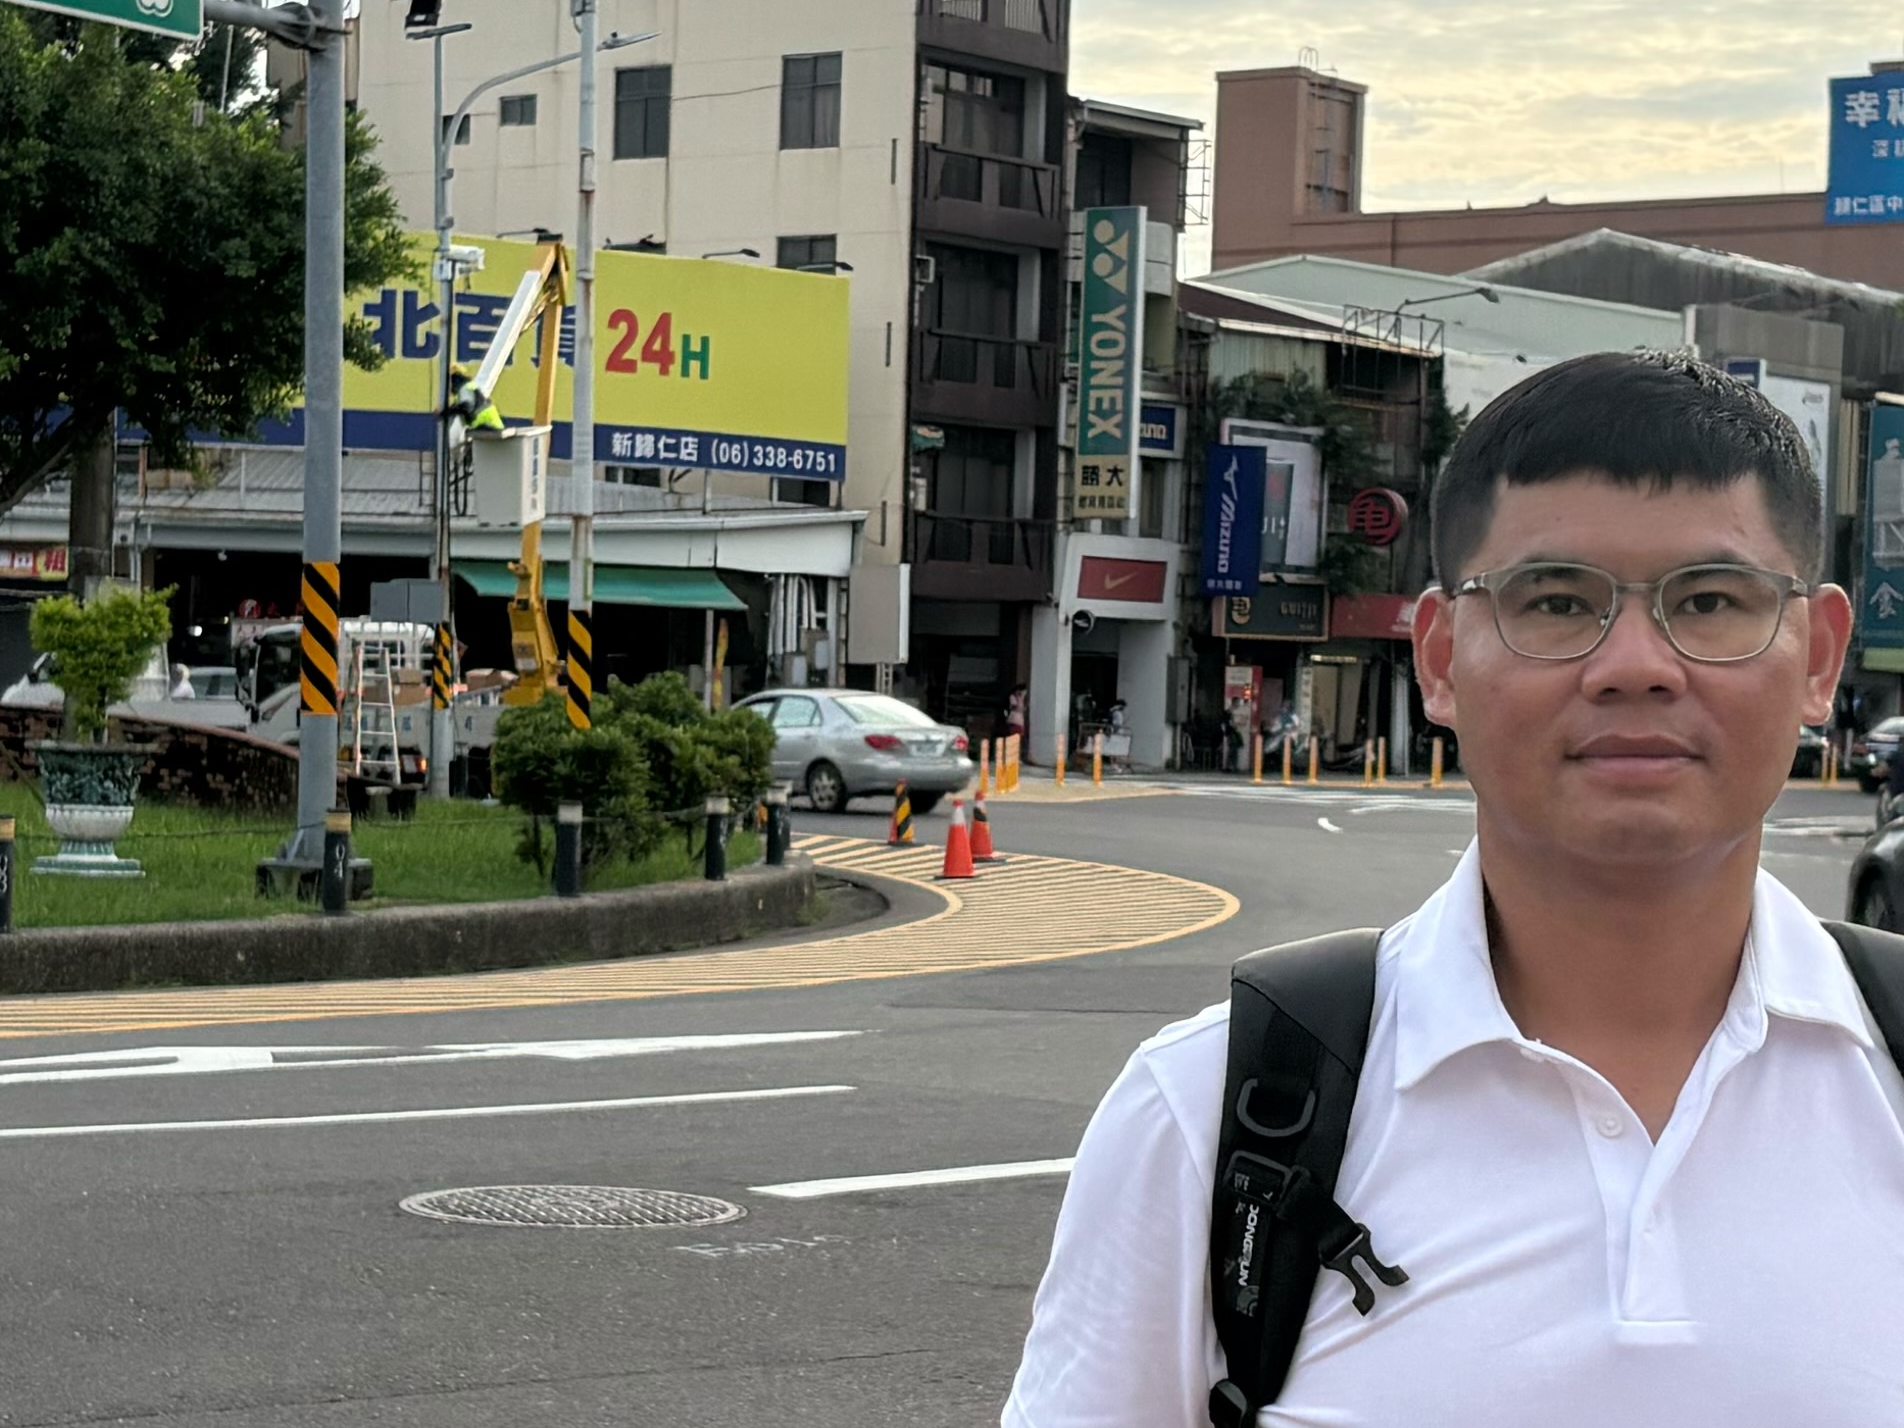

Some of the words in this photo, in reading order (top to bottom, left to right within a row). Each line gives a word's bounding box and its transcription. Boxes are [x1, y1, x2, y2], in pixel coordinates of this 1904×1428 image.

[605, 309, 710, 380] 24H
[1087, 304, 1127, 440] YONEX
[611, 432, 699, 462] 新歸仁店
